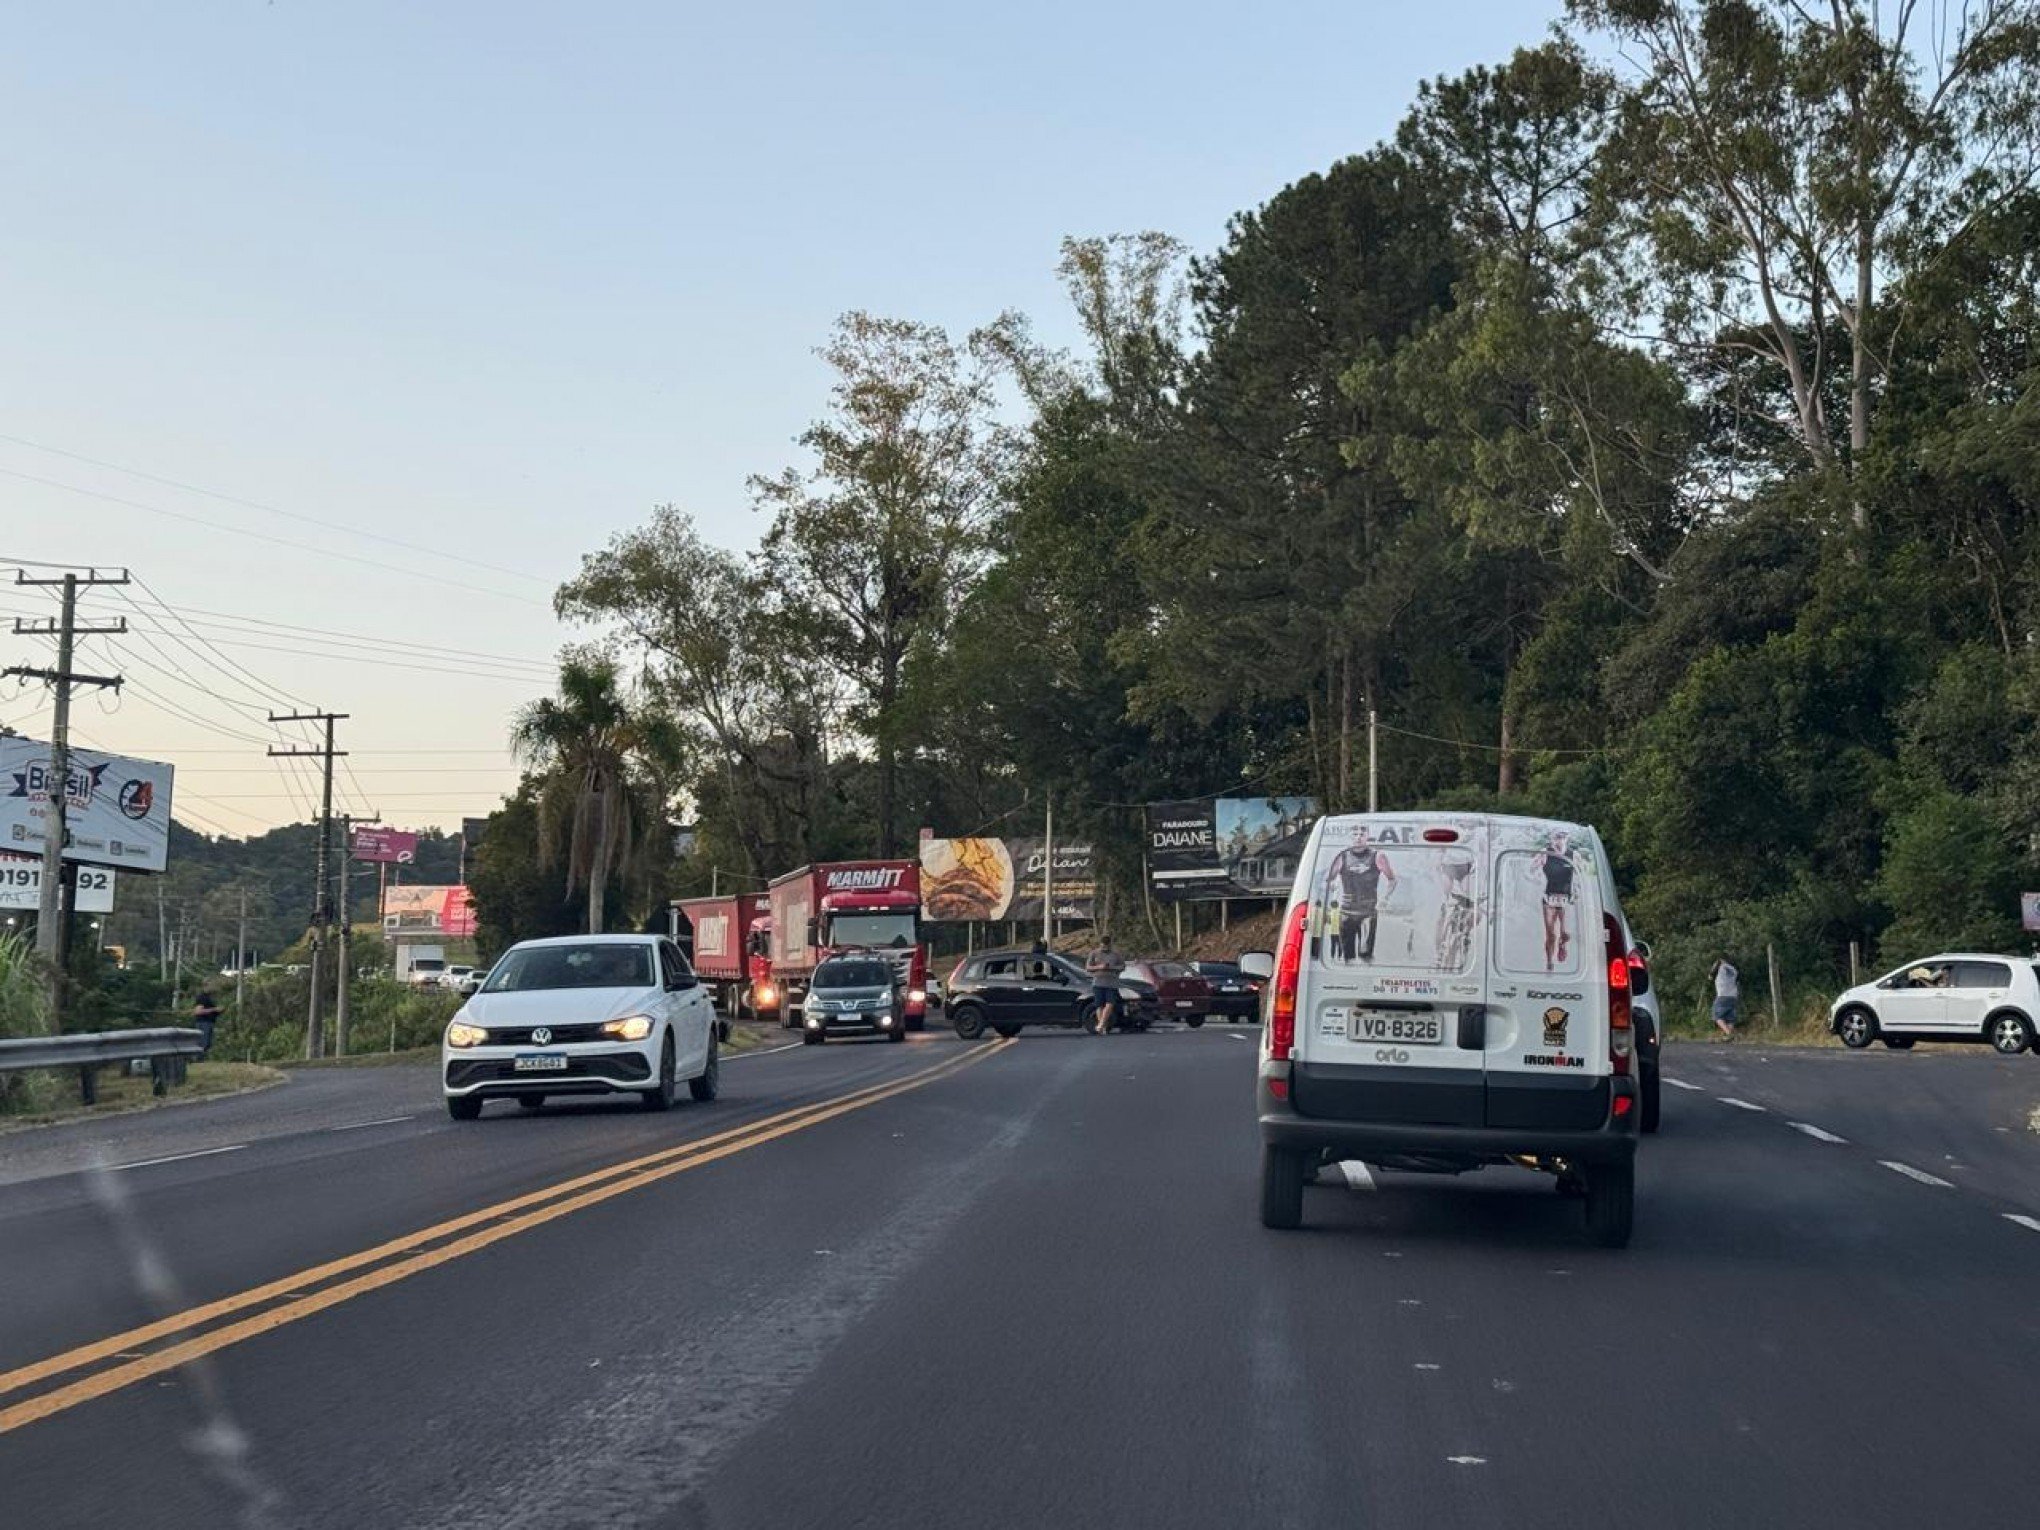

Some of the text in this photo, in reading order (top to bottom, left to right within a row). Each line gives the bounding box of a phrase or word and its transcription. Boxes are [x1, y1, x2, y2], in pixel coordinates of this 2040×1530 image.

[1153, 830, 1212, 847] DAIANE
[80, 873, 107, 889] 92
[827, 867, 905, 887] MARMITT
[1523, 1053, 1585, 1067] IRONMAN
